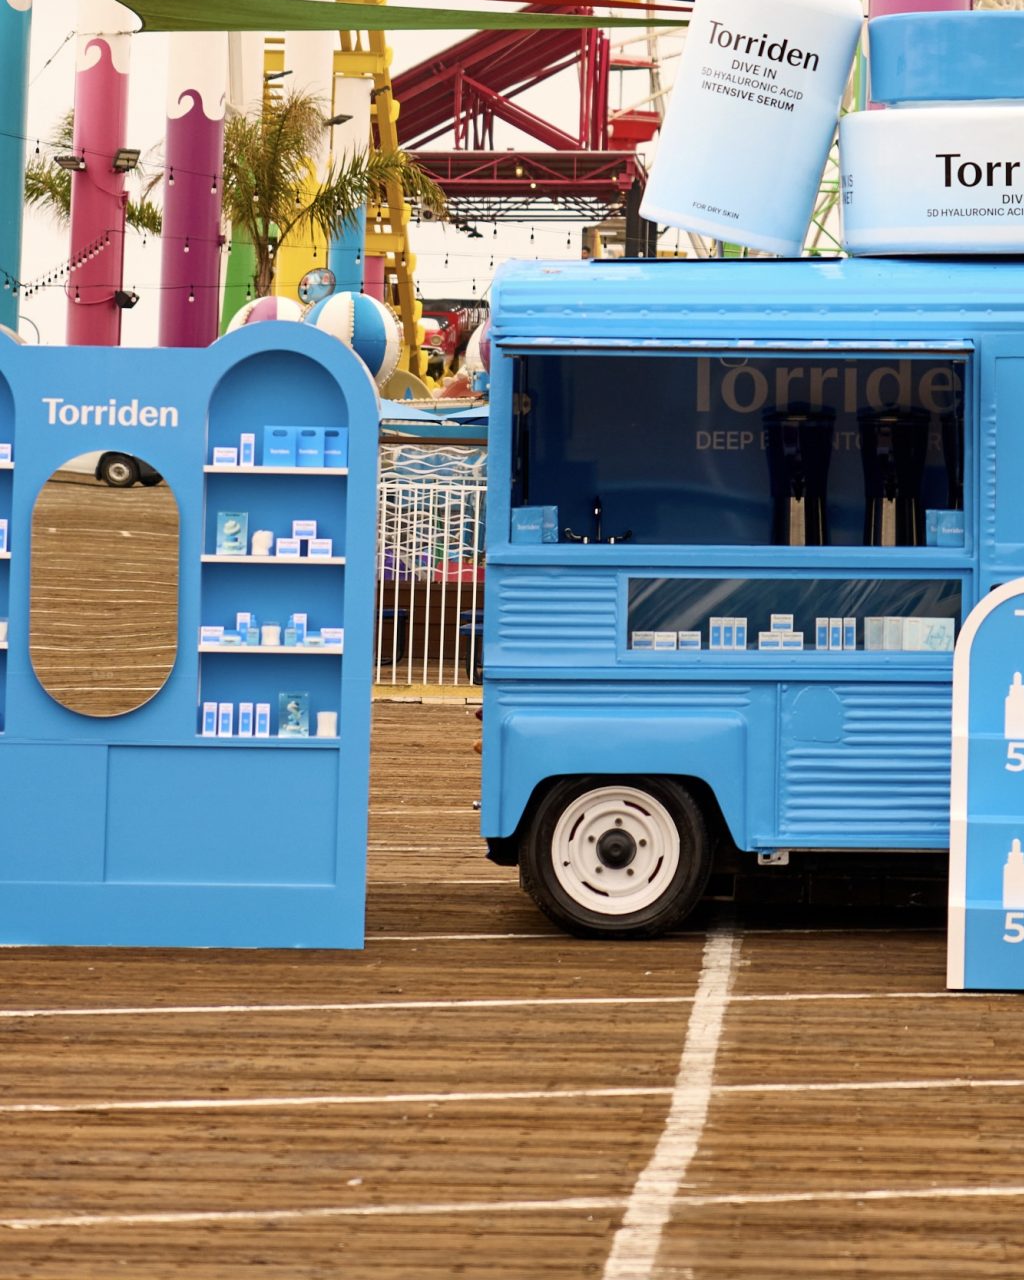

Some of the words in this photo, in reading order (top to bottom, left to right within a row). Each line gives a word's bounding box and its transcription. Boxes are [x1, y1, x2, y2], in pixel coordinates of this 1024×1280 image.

[709, 20, 819, 72] Torriden
[731, 59, 761, 76] DIVE
[763, 67, 778, 80] IN
[701, 66, 713, 77] 5D
[713, 70, 779, 94] HYALURONIC
[780, 88, 804, 101] ACID
[701, 80, 755, 102] INTENSIVE
[756, 94, 795, 113] SERUM
[707, 205, 721, 215] DRY
[927, 208, 939, 217] 5D
[941, 207, 1005, 217] HYALURONIC
[41, 397, 180, 429] Torriden
[695, 431, 754, 451] DEEP
